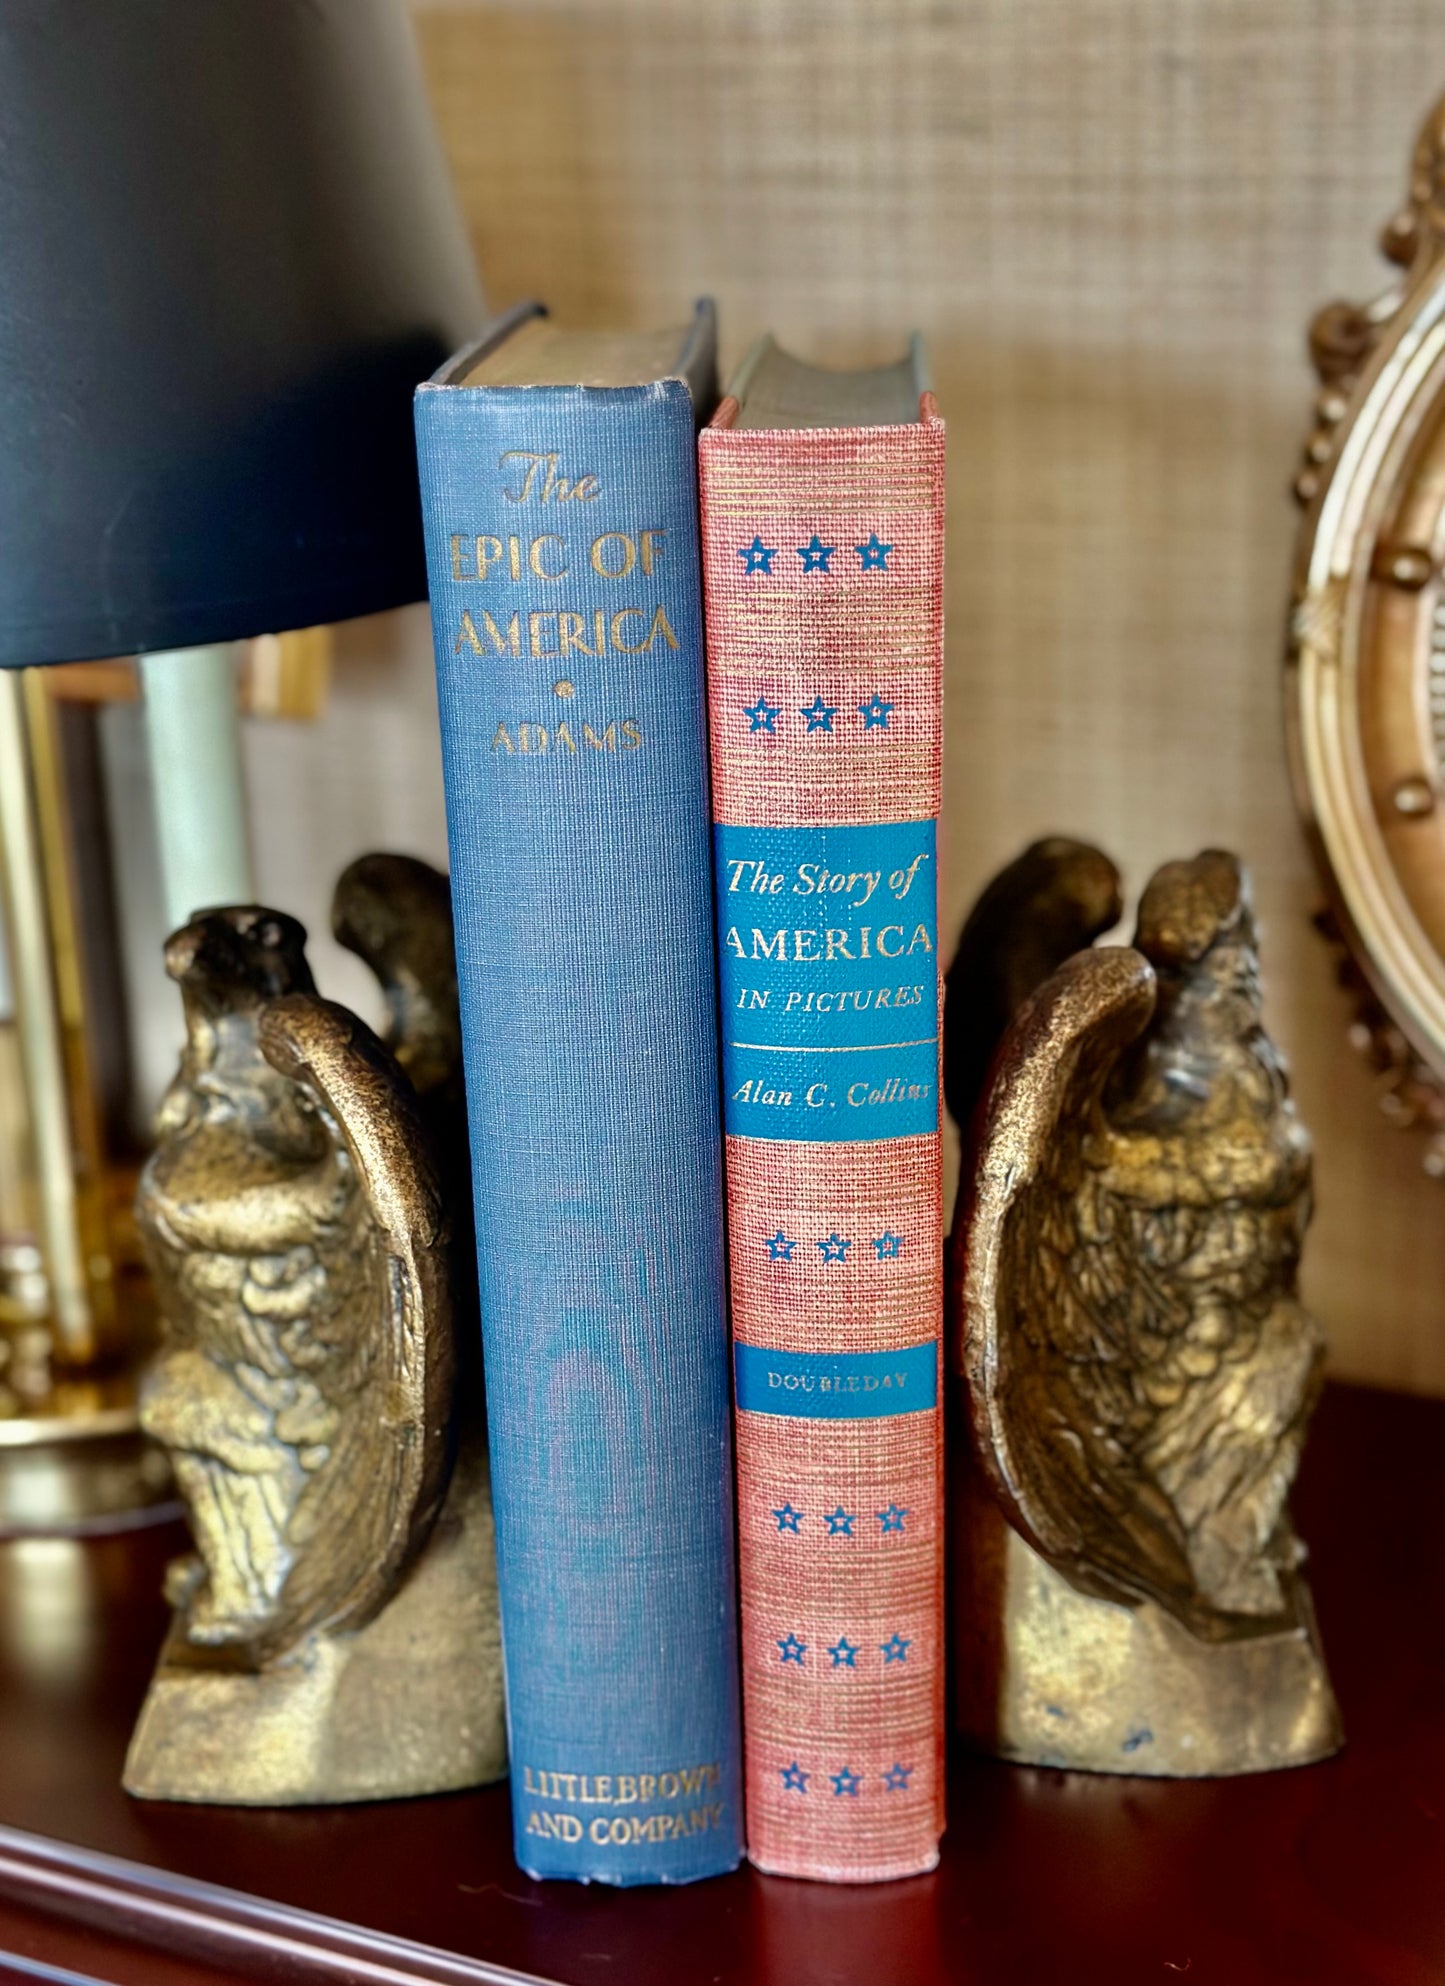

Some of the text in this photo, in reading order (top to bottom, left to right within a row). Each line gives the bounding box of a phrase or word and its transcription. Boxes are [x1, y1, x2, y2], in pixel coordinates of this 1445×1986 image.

[498, 450, 603, 504] The
[450, 529, 667, 582] EPIC OF
[455, 604, 680, 657] AMERICA
[491, 719, 643, 753] ADAMS
[726, 853, 930, 908] The Story of
[725, 924, 934, 961] AMERICA
[736, 985, 924, 1012] IN PICTURES
[732, 1078, 929, 1108] Alan C. Collins
[767, 1372, 907, 1392] DOUBLEDAY
[526, 1802, 724, 1845] AND COMPANY
